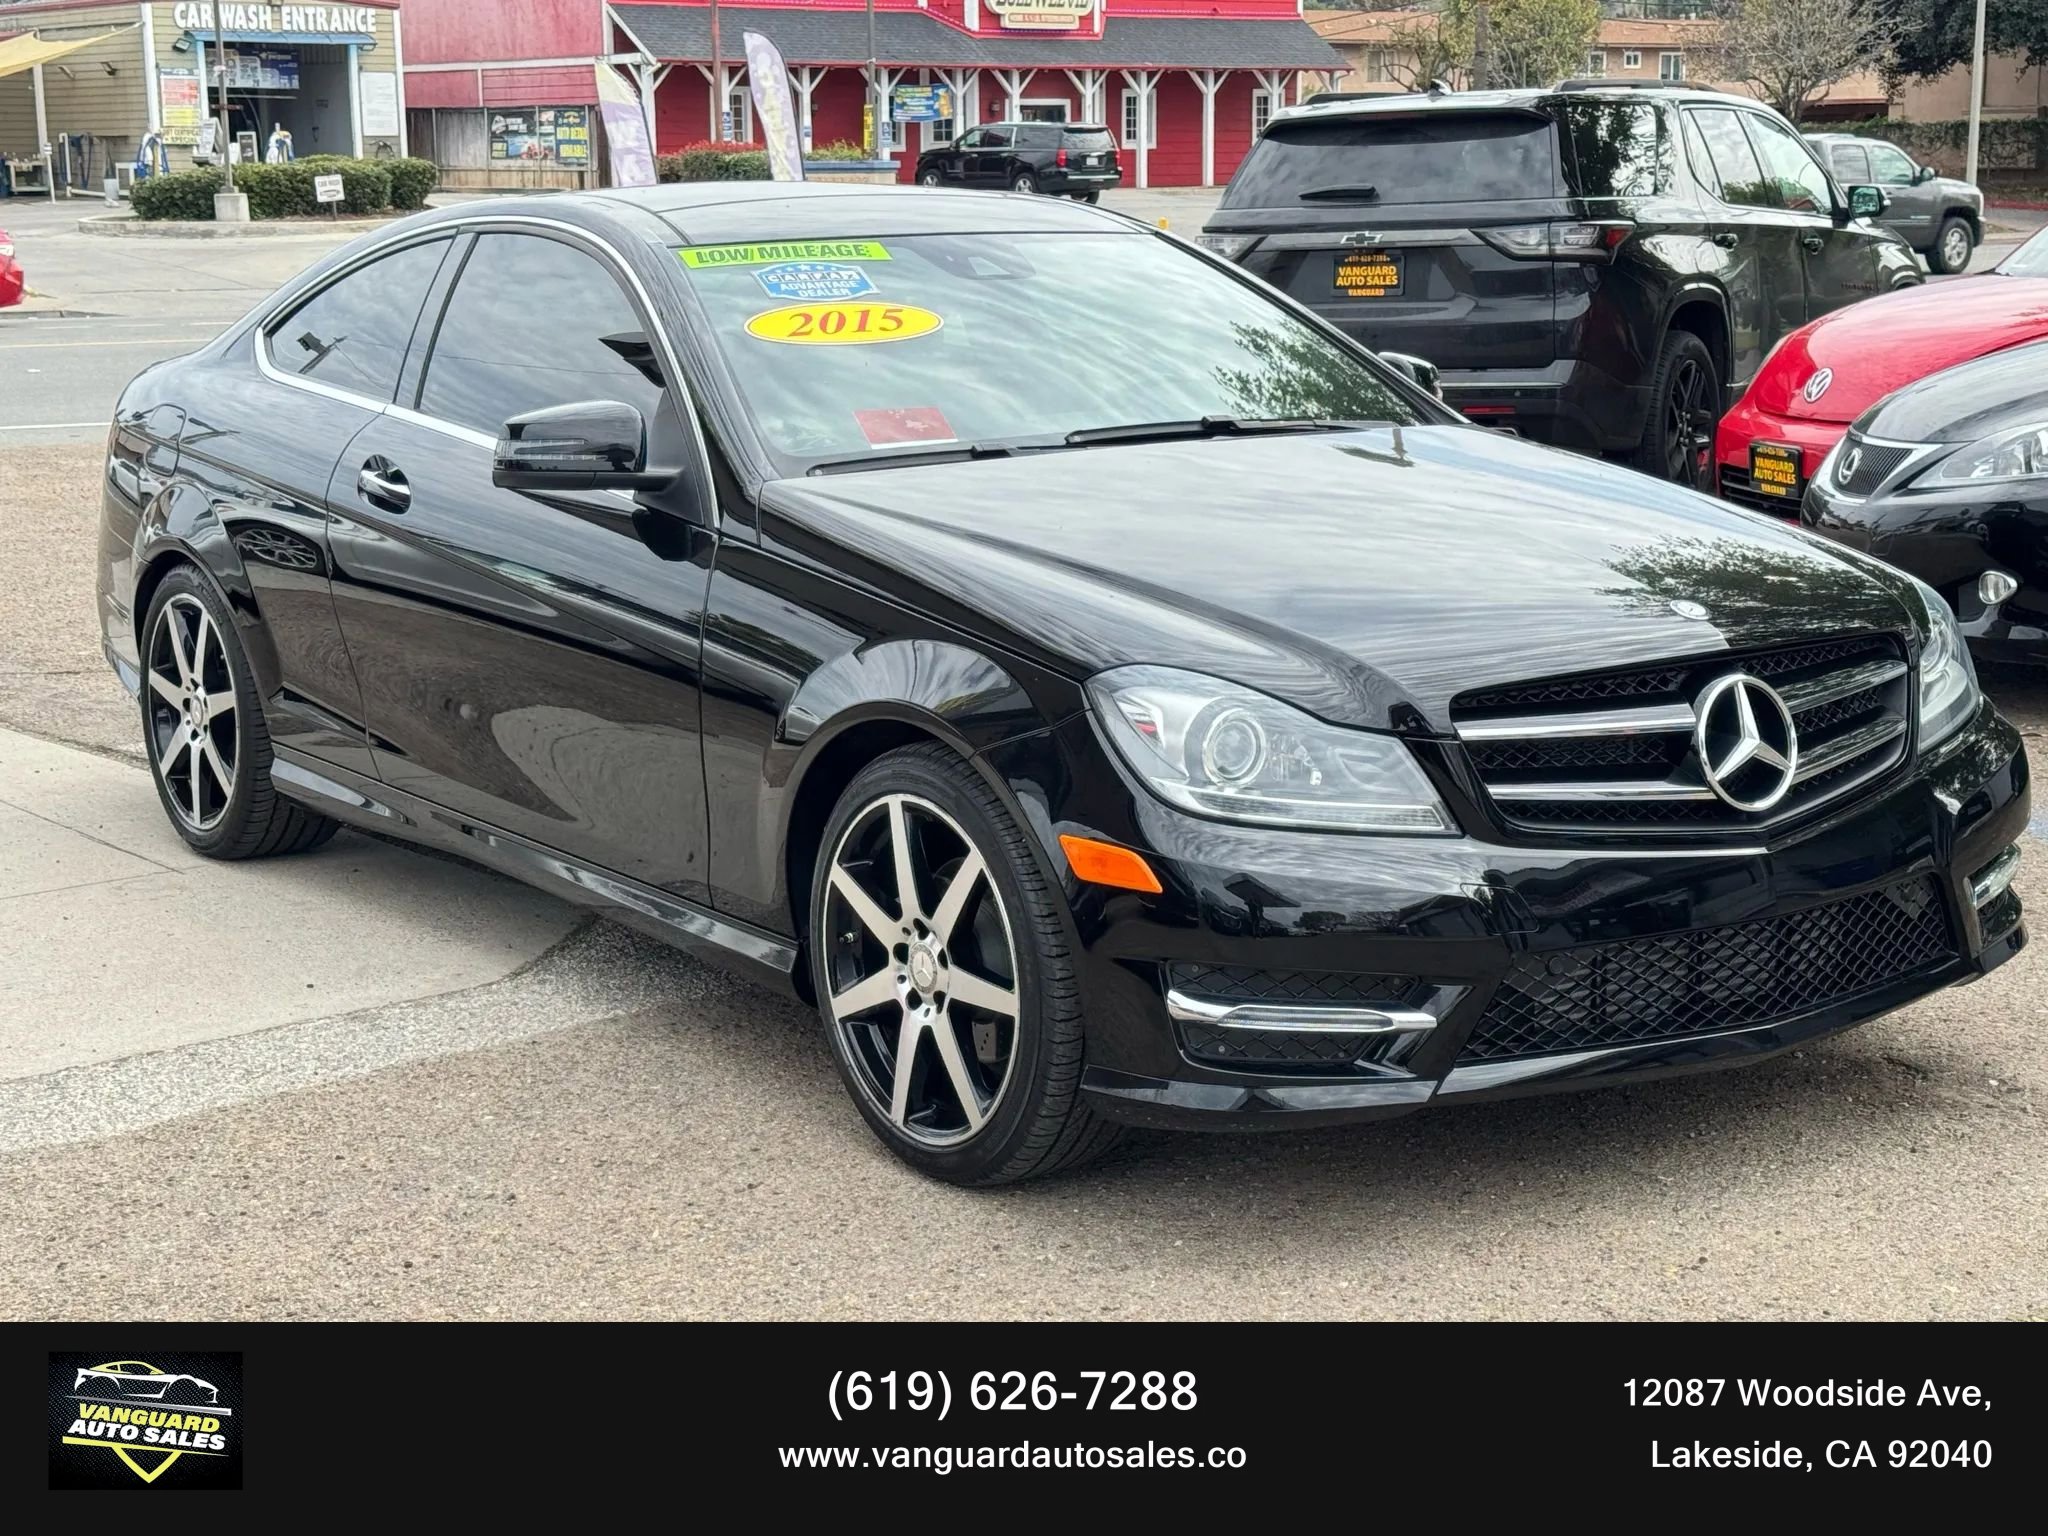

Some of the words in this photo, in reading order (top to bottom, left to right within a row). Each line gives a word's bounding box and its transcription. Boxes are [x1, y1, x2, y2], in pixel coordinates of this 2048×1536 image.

[174, 3, 214, 30] CAR
[218, 3, 273, 31] WASH
[281, 5, 377, 33] ENTRANCE
[695, 248, 754, 263] LOW
[757, 243, 872, 261] MILEAGE
[766, 271, 860, 283] CARFAX
[1339, 266, 1396, 276] VANGUARD
[780, 280, 859, 291] ADVANTAGE
[1336, 276, 1365, 286] AUTO
[1366, 275, 1398, 285] SALES
[797, 287, 851, 298] DEALER
[787, 308, 904, 337] 2015
[1755, 456, 1795, 473] VANGUARD
[1753, 468, 1773, 481] AUTO
[1773, 471, 1796, 485] SALES
